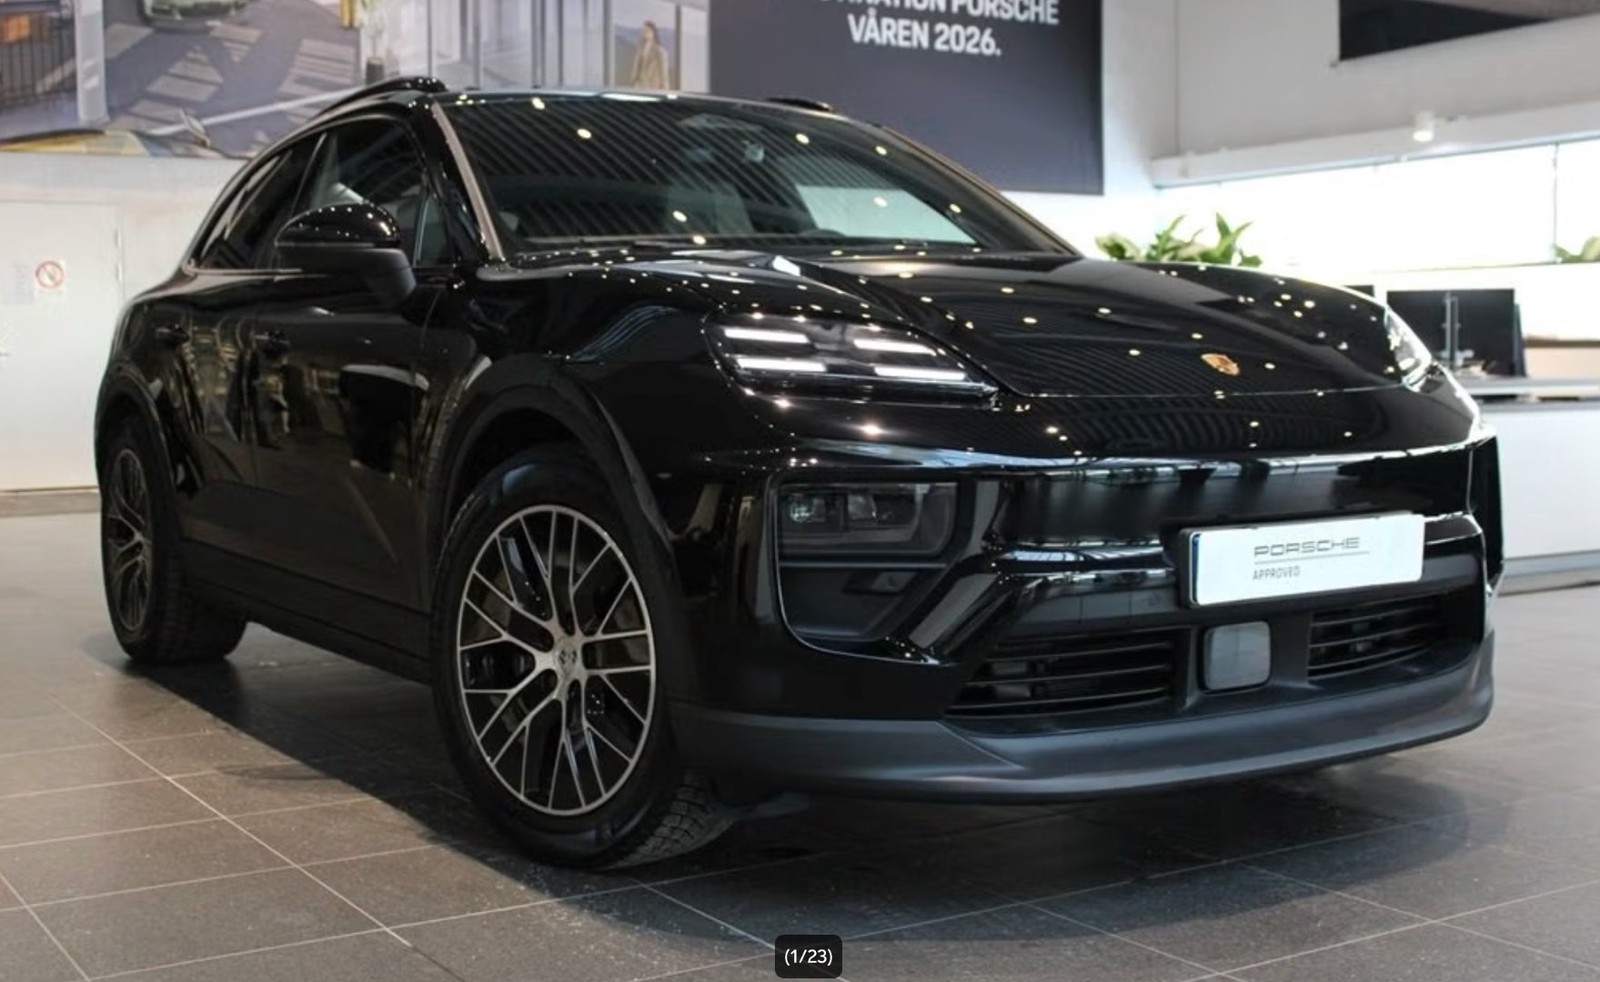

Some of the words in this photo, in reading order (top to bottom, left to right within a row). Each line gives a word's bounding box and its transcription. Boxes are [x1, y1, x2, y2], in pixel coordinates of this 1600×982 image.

[847, 7, 929, 49] VÅREN
[934, 22, 1001, 56] 2026.
[1254, 537, 1360, 557] PORSCHE
[1253, 566, 1300, 580] APPROVED
